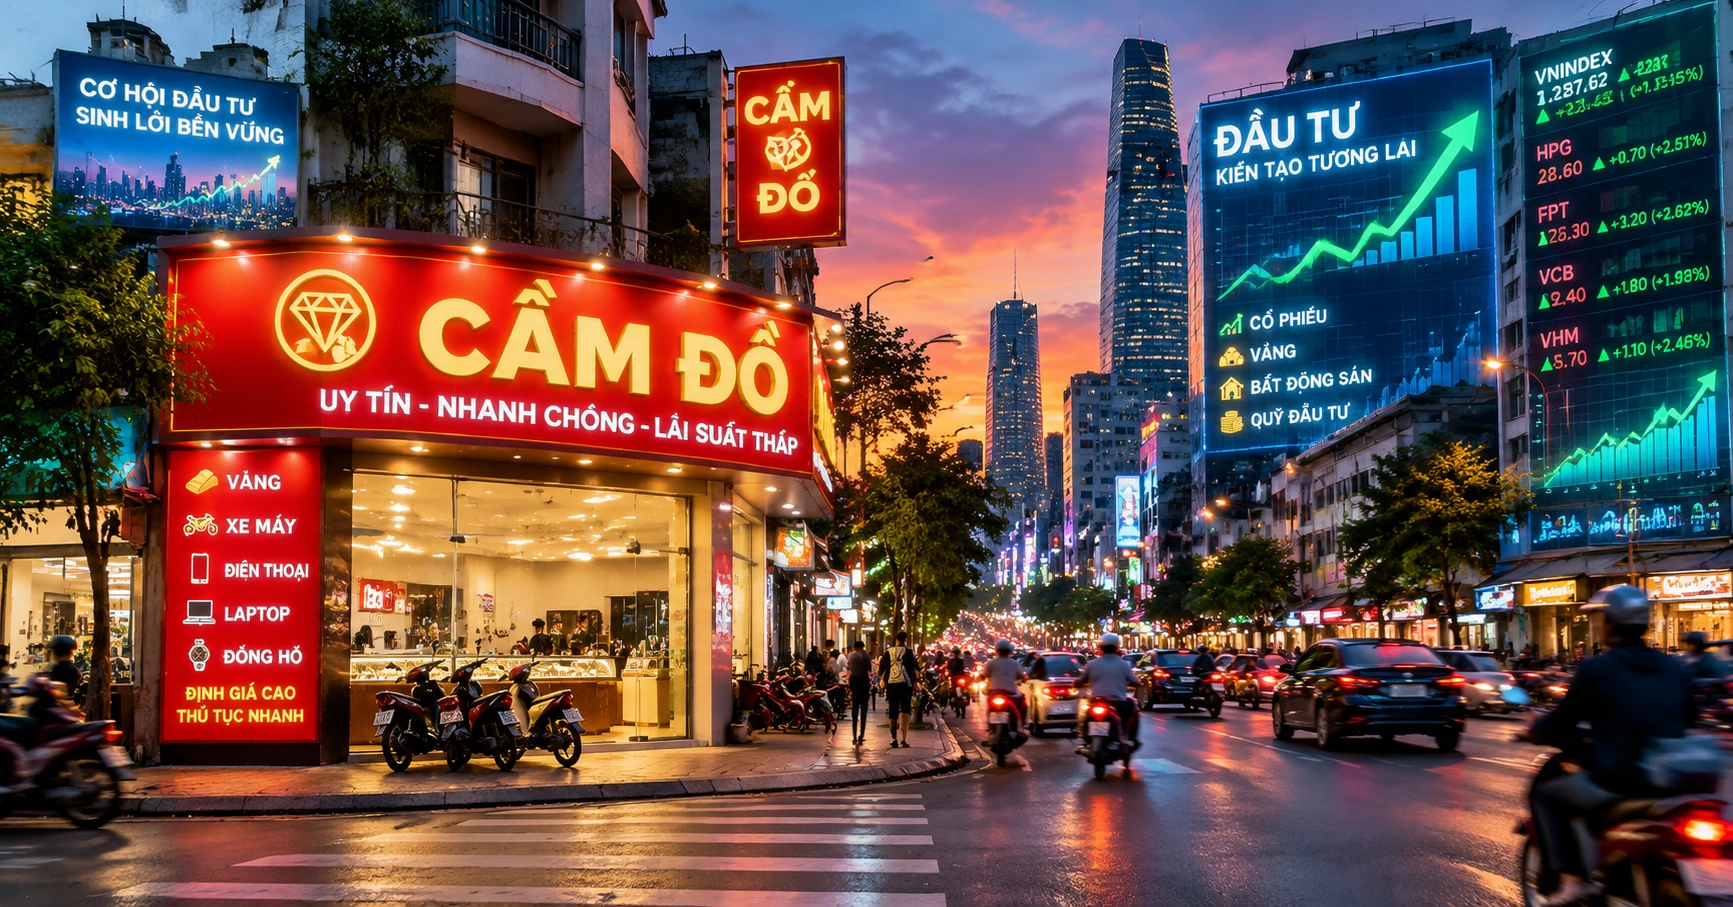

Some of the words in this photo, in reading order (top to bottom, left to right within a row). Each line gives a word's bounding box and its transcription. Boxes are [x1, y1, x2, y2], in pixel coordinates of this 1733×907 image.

[1535, 49, 1613, 85] VNINDEX
[79, 77, 118, 99] CƠ
[124, 81, 165, 109] HỘI
[226, 96, 257, 116] TƯ
[76, 106, 128, 128] SINH
[1213, 108, 1296, 158] ĐẦU
[1307, 100, 1361, 143] TƯ
[1537, 139, 1572, 162] HPG
[1264, 158, 1303, 182] TẠO
[1308, 146, 1378, 172] TƯƠNG
[1537, 160, 1583, 185] 28.60
[1538, 201, 1570, 224] FPT
[1539, 264, 1575, 286] VCB
[419, 278, 651, 396] CẦM
[674, 320, 789, 415] ĐỒ
[1540, 327, 1579, 349] VHM
[320, 388, 358, 412] UY
[437, 395, 537, 424] NHANH
[1327, 402, 1351, 420] TƯ
[226, 518, 250, 534] XE
[263, 563, 309, 582] THOẠI
[224, 606, 291, 622] LAPTOP
[185, 686, 225, 703] ĐỊNH
[229, 682, 258, 700] GIÁ
[262, 686, 296, 700] CAO
[213, 709, 244, 726] TỤC
[248, 709, 304, 723] NHANH
